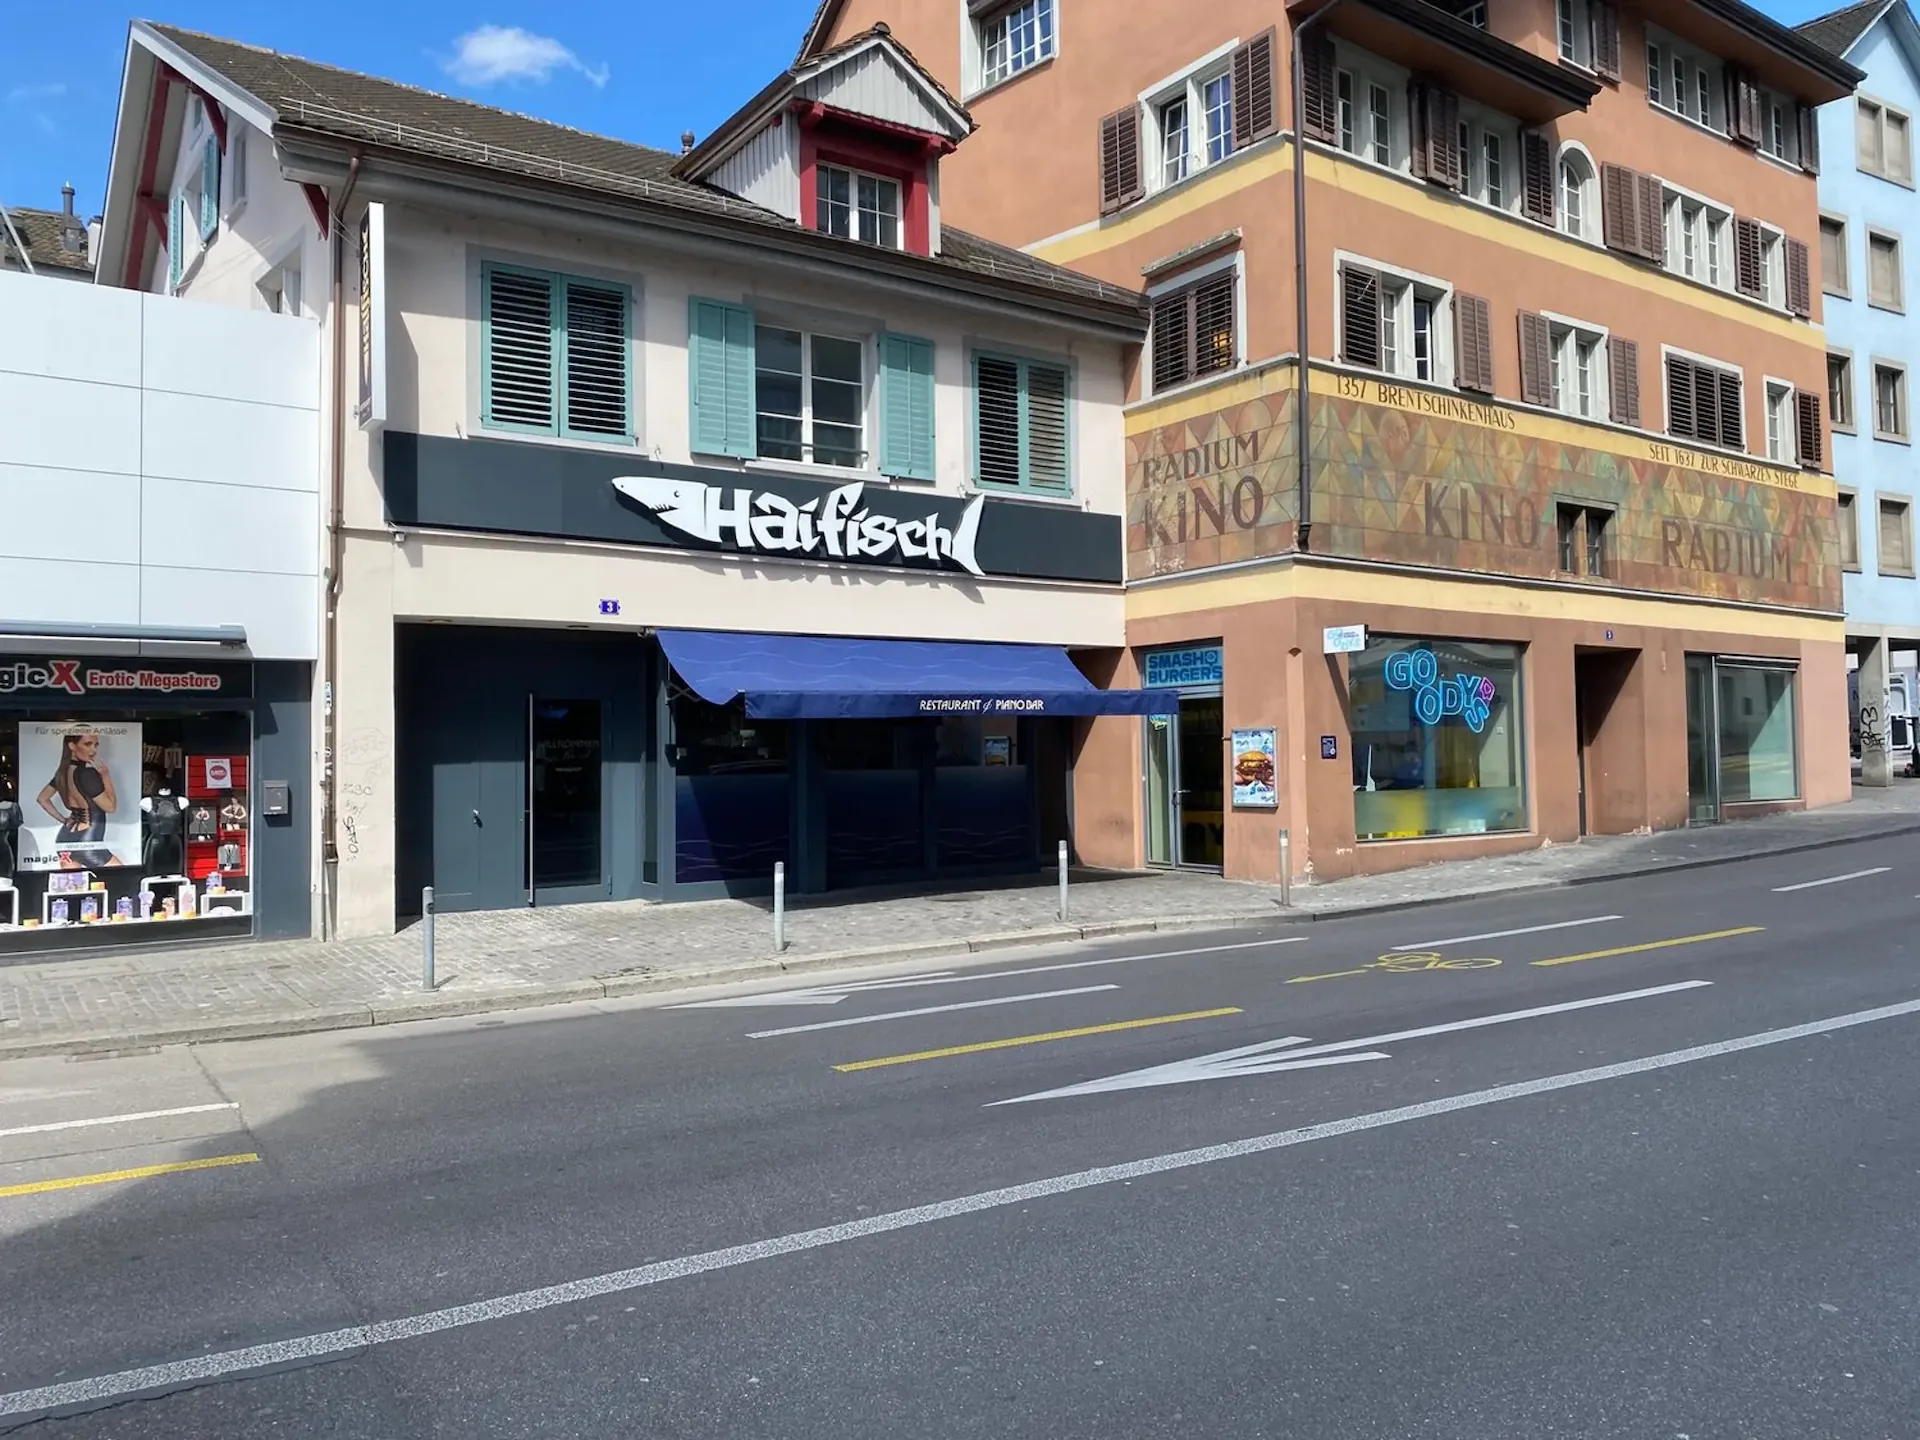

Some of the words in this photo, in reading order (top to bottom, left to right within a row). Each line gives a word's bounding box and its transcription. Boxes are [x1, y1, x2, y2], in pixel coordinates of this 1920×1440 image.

[1336, 374, 1367, 399] 1357
[1378, 383, 1516, 430] BRENTSCHINKENHAUS
[1143, 430, 1259, 489] RADIUM
[1649, 443, 1670, 463] SEIT
[1675, 449, 1696, 467] 1637
[1700, 452, 1719, 472] ZUR
[704, 480, 952, 561] Haifisch
[1144, 475, 1264, 546] KINO
[1424, 482, 1540, 549] KINO
[1661, 518, 1792, 584] RADIUM
[87, 671, 135, 688] Erotic
[138, 671, 220, 691] Megastore
[1148, 650, 1204, 669] SMASH
[1148, 666, 1223, 684] BURGERS
[919, 699, 982, 711] RESTAURANT
